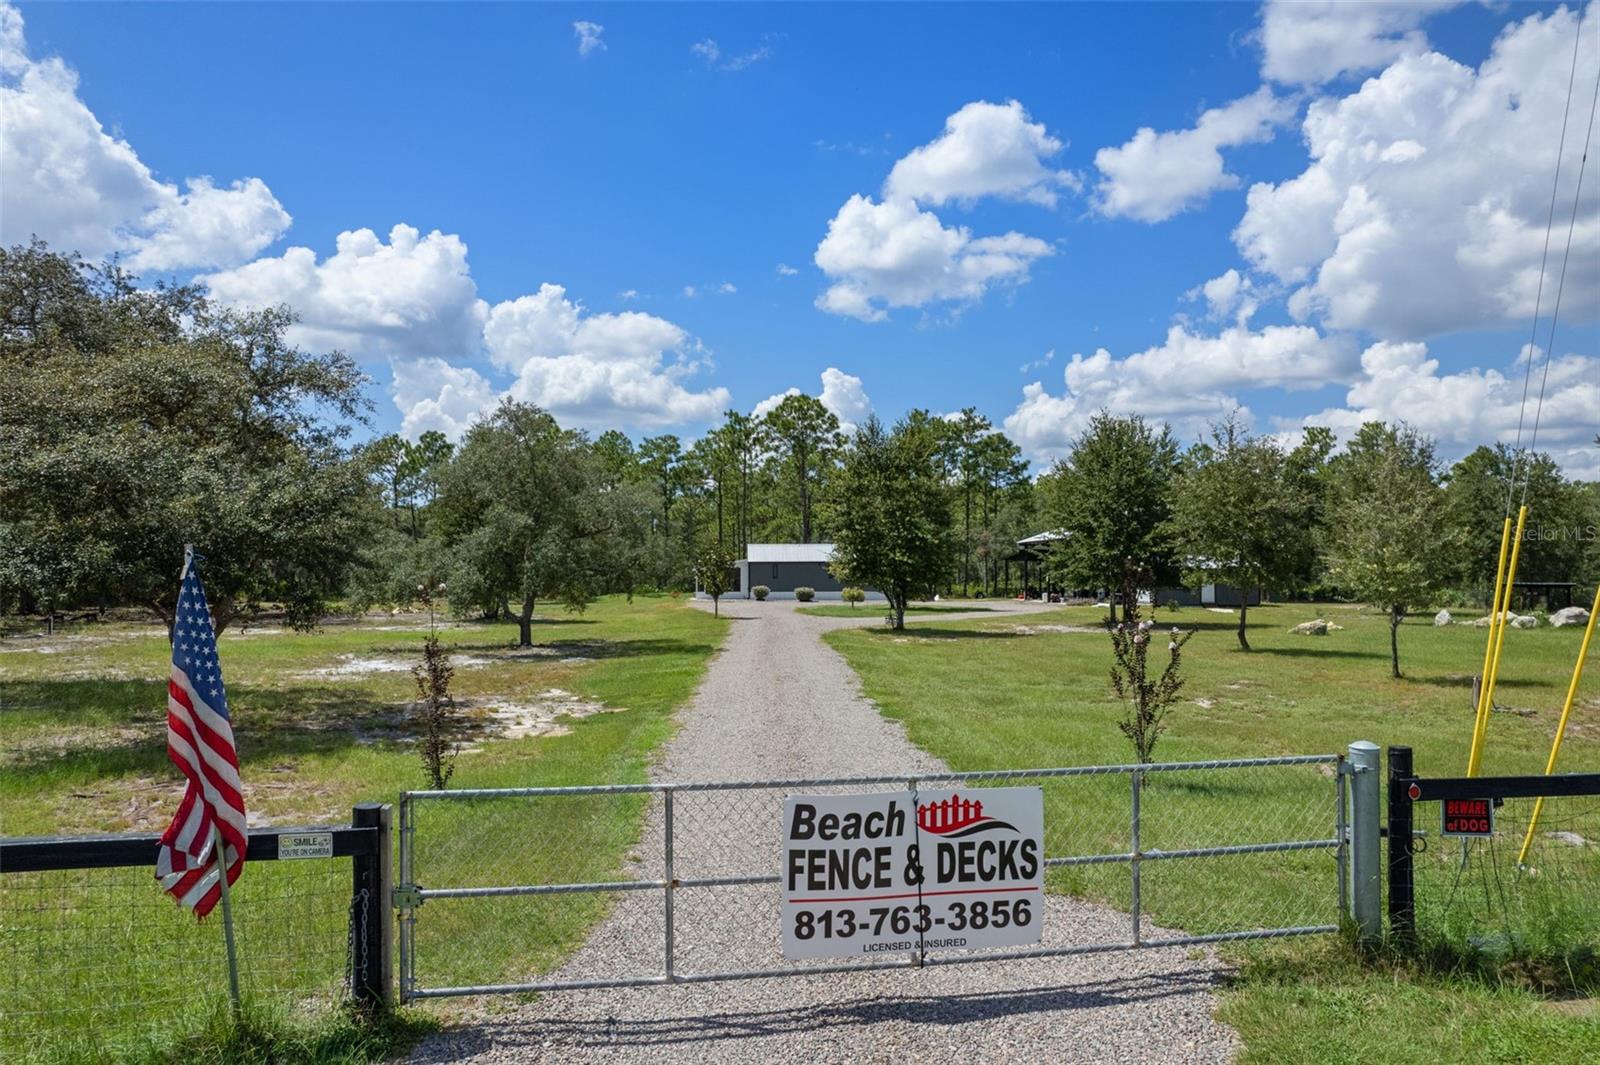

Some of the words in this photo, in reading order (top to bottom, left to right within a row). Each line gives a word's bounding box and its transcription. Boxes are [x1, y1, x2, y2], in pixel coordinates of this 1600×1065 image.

[1447, 800, 1487, 815] BEWARE
[790, 801, 906, 841] Beach
[1447, 820, 1457, 831] of
[1460, 819, 1488, 831] DOG
[293, 837, 318, 847] SMILE
[280, 848, 299, 857] YOU'RE
[300, 848, 309, 856] ON
[309, 847, 329, 856] CAMERA
[788, 846, 892, 891] FENCE
[903, 844, 926, 886] &
[937, 839, 1039, 884] DECKS
[794, 899, 1032, 940] 813-763-3856
[863, 941, 912, 953] LICENSED
[924, 938, 967, 949] INSURED
